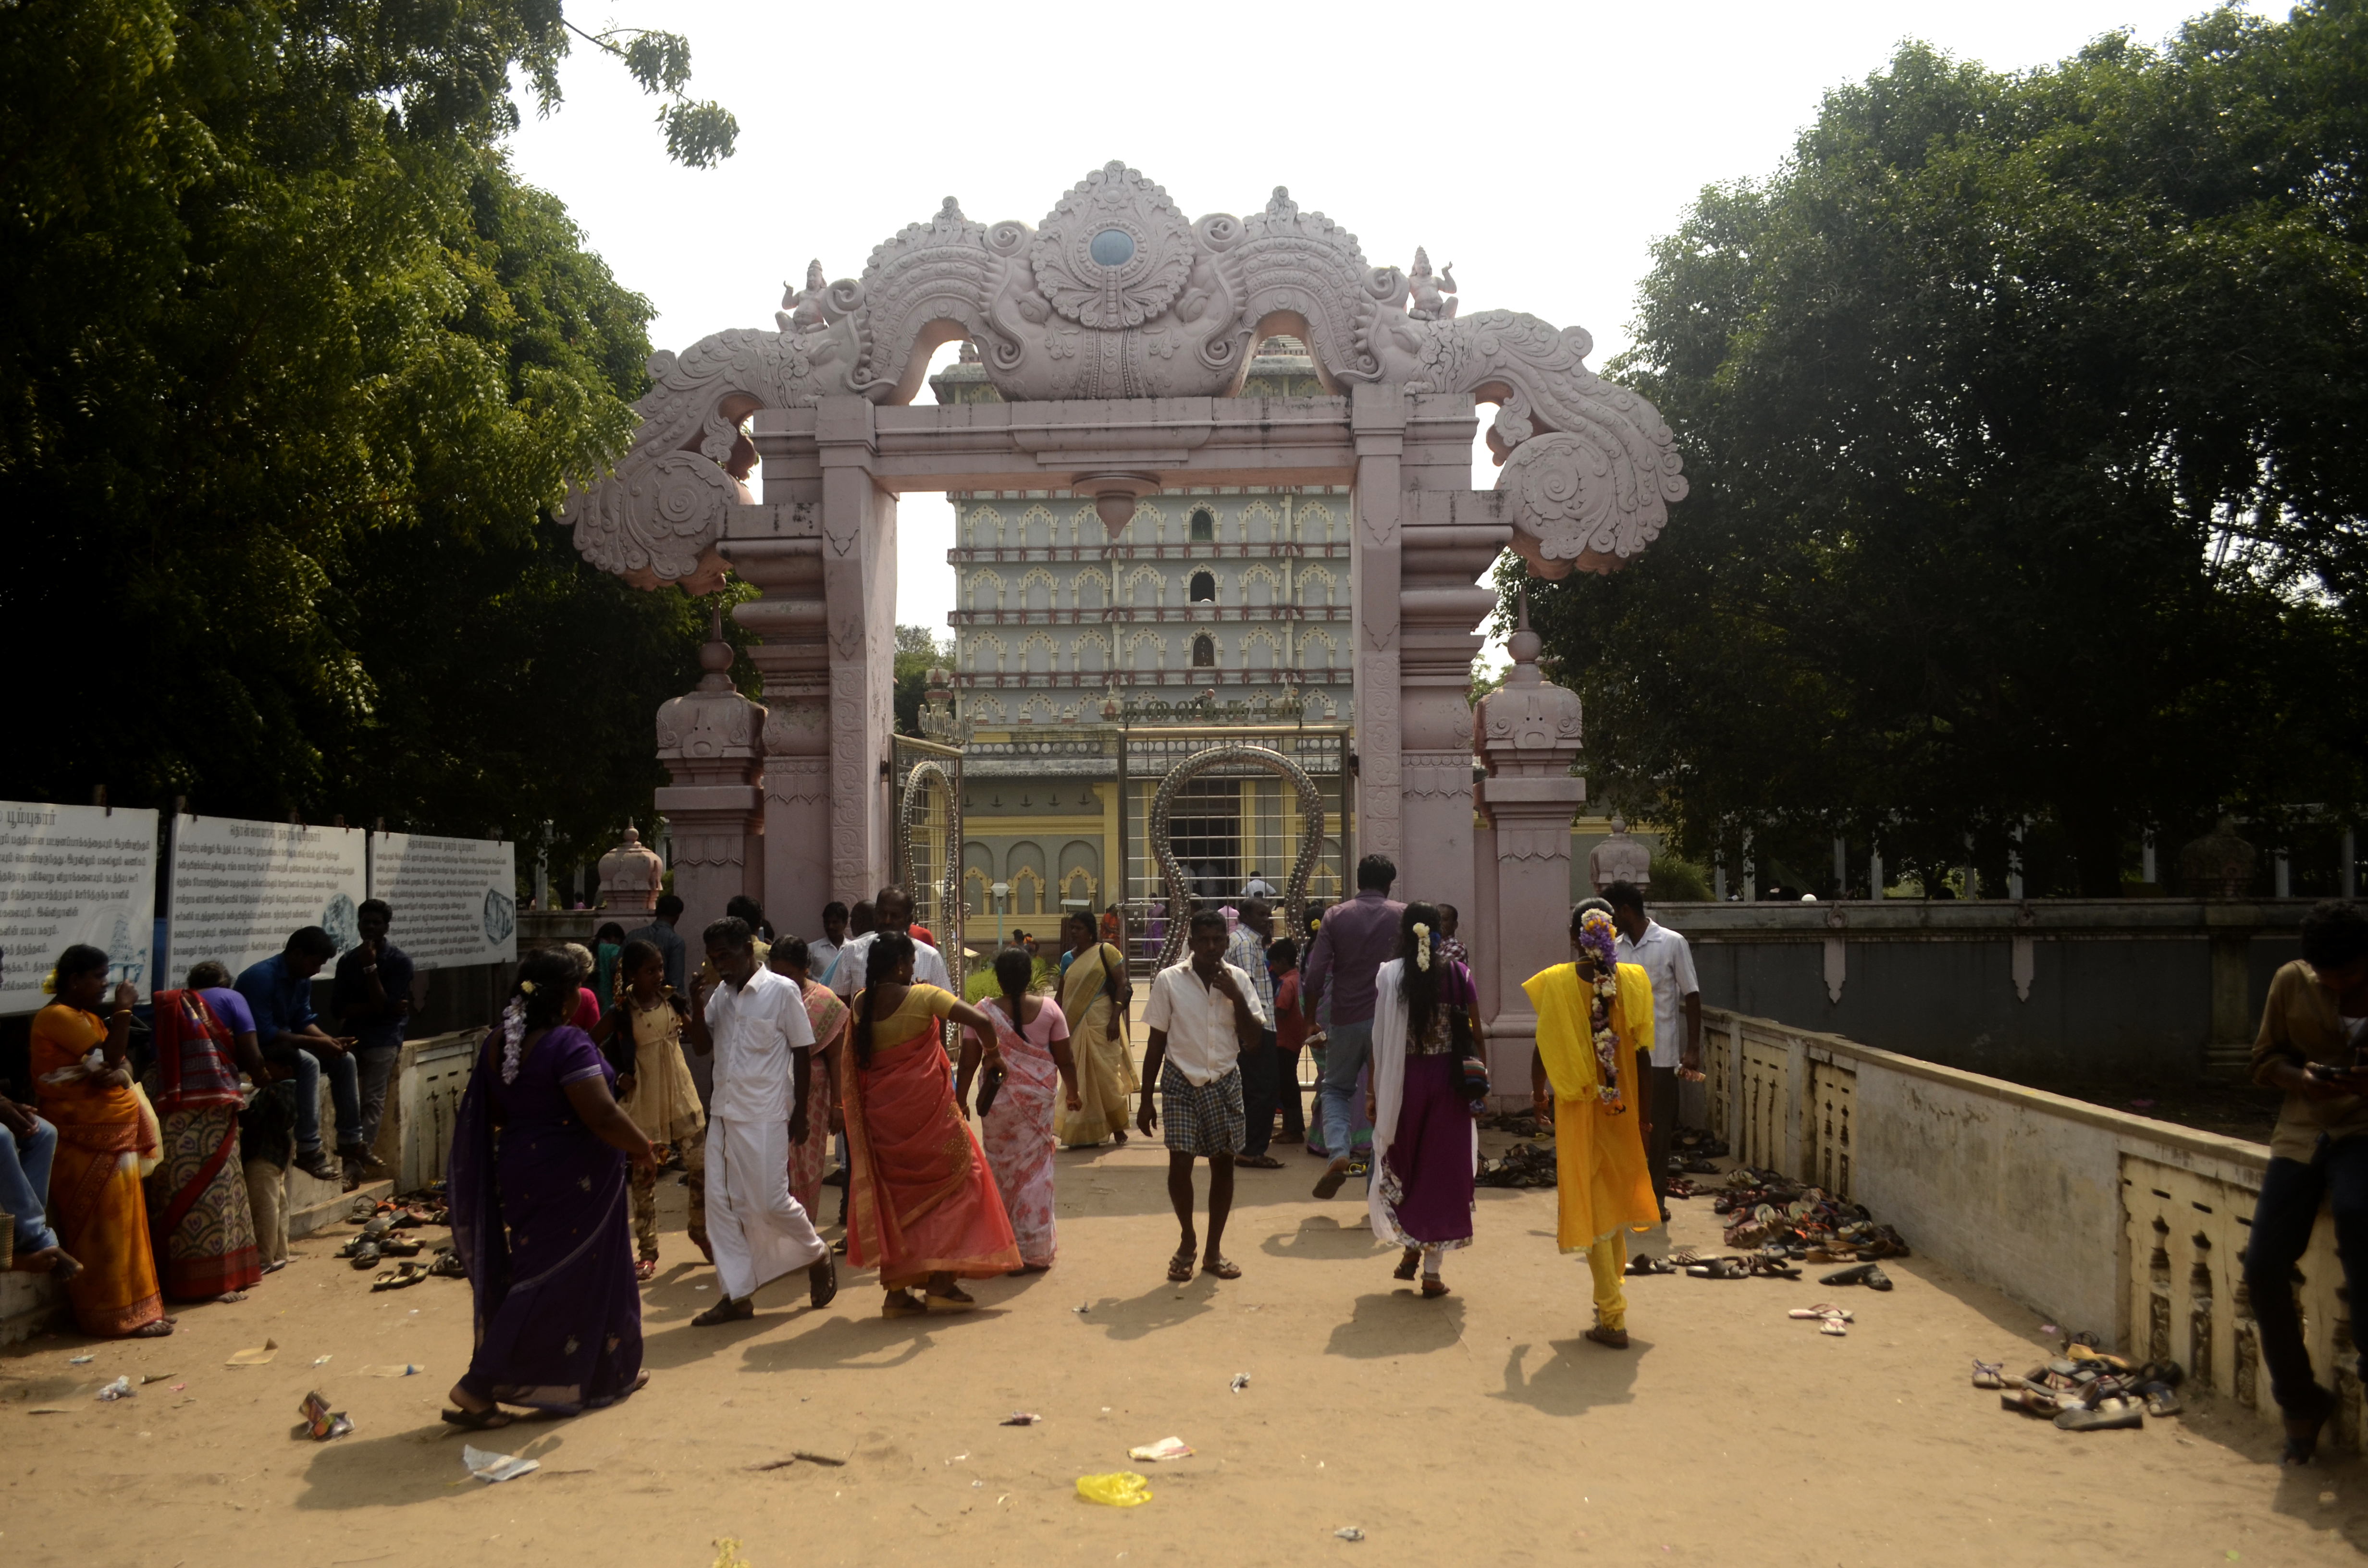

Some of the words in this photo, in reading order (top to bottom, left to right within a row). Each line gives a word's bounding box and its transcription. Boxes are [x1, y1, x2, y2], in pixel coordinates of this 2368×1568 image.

[7, 807, 57, 829] பூம்புகார்
[231, 823, 275, 839] தொன்மையான
[12, 835, 44, 846] பகுதியான
[28, 871, 55, 883] பல்வேறு
